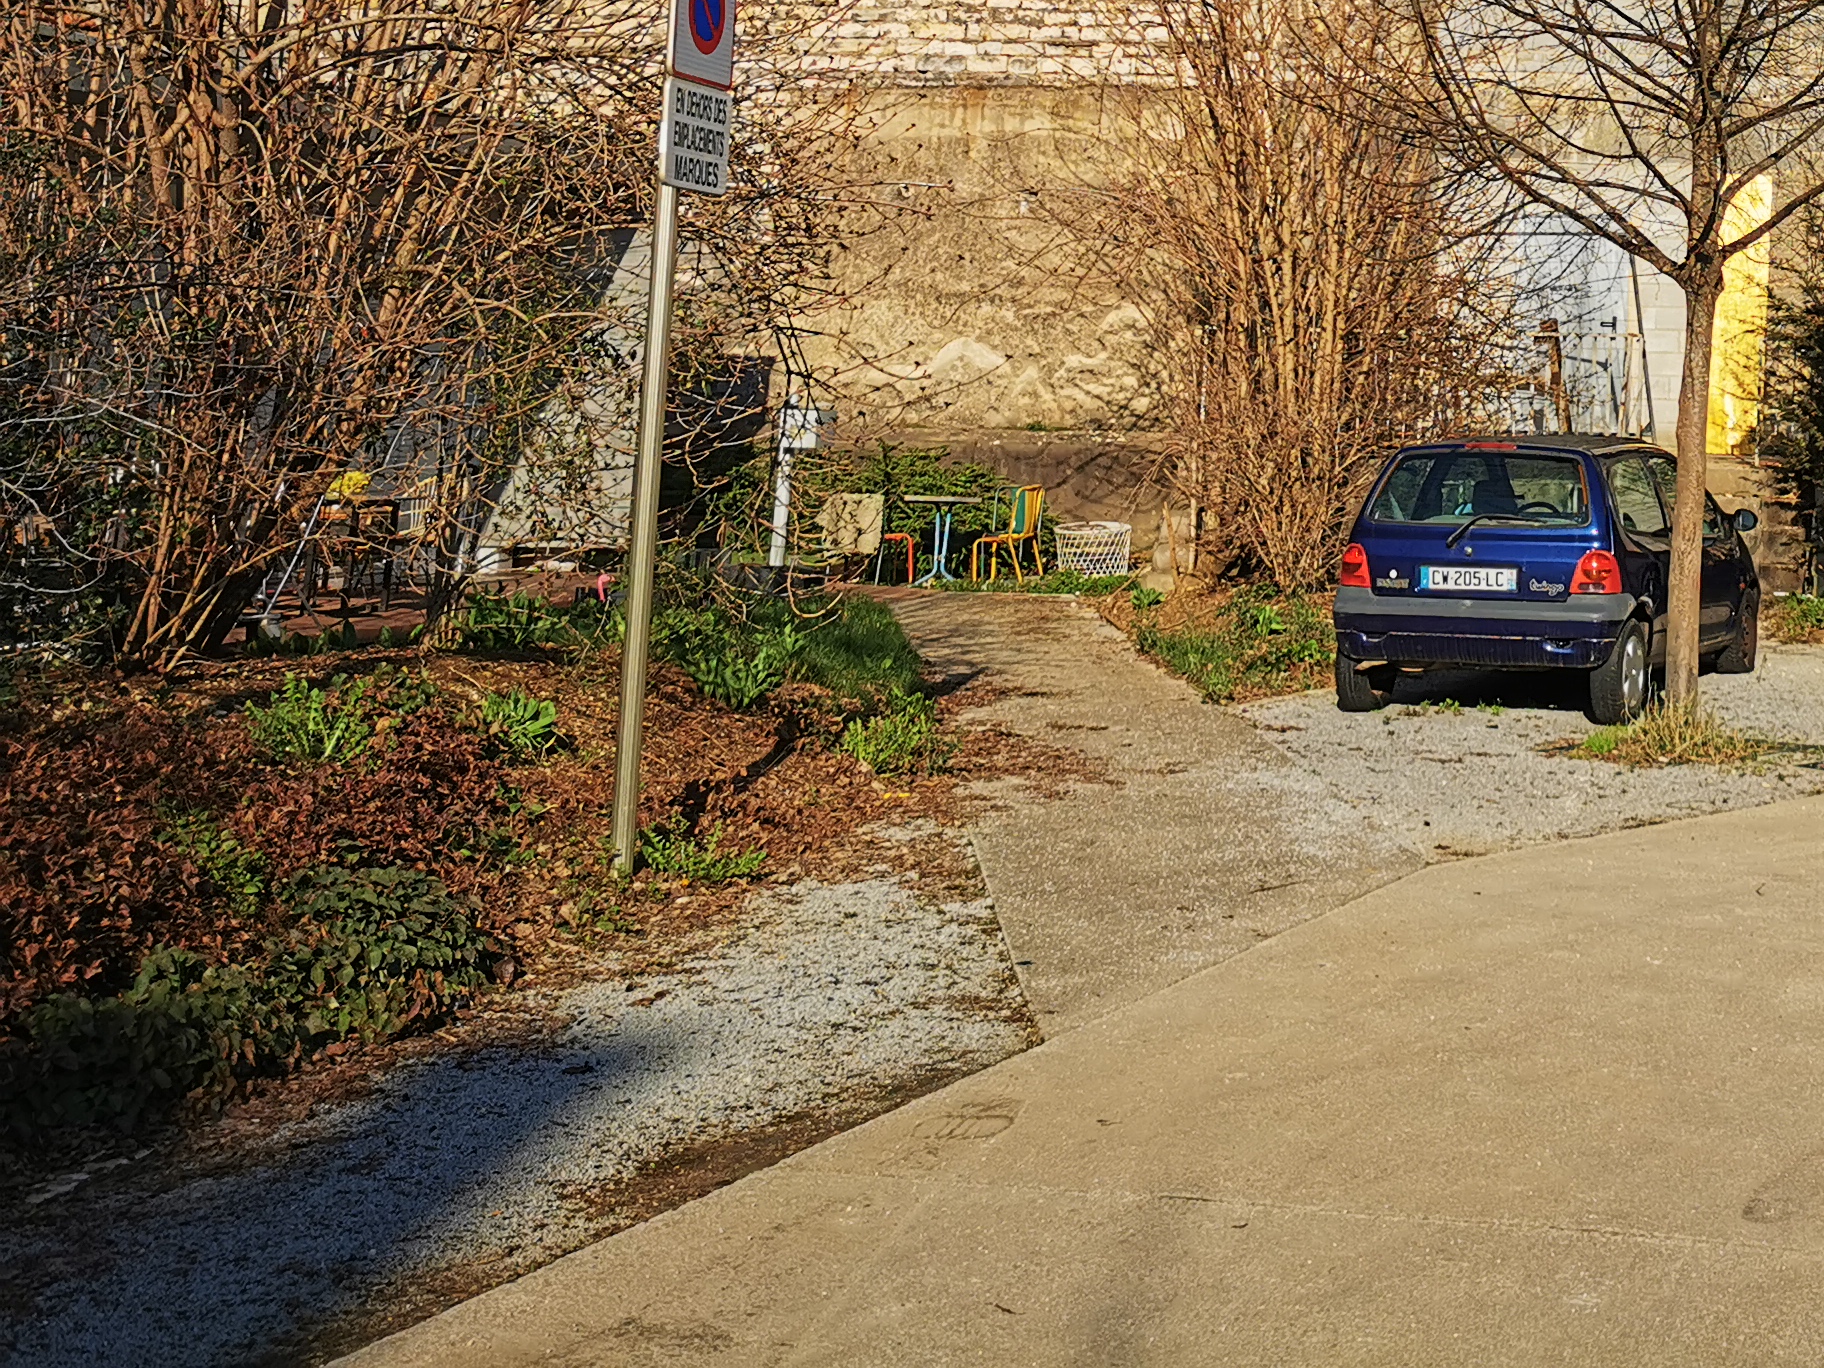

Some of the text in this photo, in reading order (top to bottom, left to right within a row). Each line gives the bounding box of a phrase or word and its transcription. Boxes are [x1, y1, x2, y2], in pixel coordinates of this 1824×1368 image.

[675, 87, 728, 126] EN DEHORS DES
[673, 121, 725, 158] EMPLACEMENTS
[674, 154, 719, 188] MARQUES
